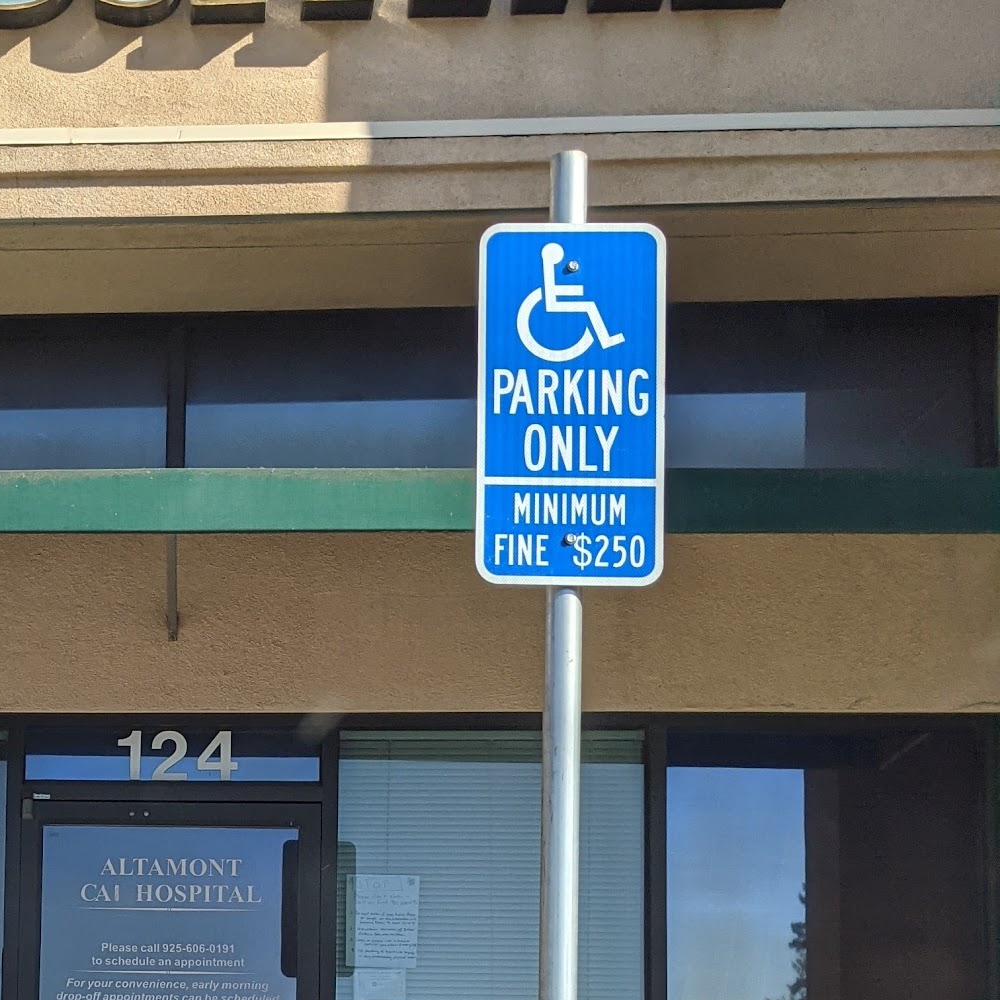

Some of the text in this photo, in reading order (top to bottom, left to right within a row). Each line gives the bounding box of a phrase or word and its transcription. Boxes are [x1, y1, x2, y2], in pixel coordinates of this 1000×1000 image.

[493, 368, 650, 417] PARKING
[523, 423, 620, 472] ONLY
[513, 492, 626, 525] MINIMUM
[493, 532, 646, 569] FINE $250
[117, 730, 239, 781] 124
[100, 858, 243, 877] ALTAMONT
[137, 884, 262, 903] HOSPITAL
[101, 943, 235, 954] Please call 925-606-0191
[91, 956, 245, 968] to schedule an appointment
[66, 978, 269, 993] For your convenience, early morning
